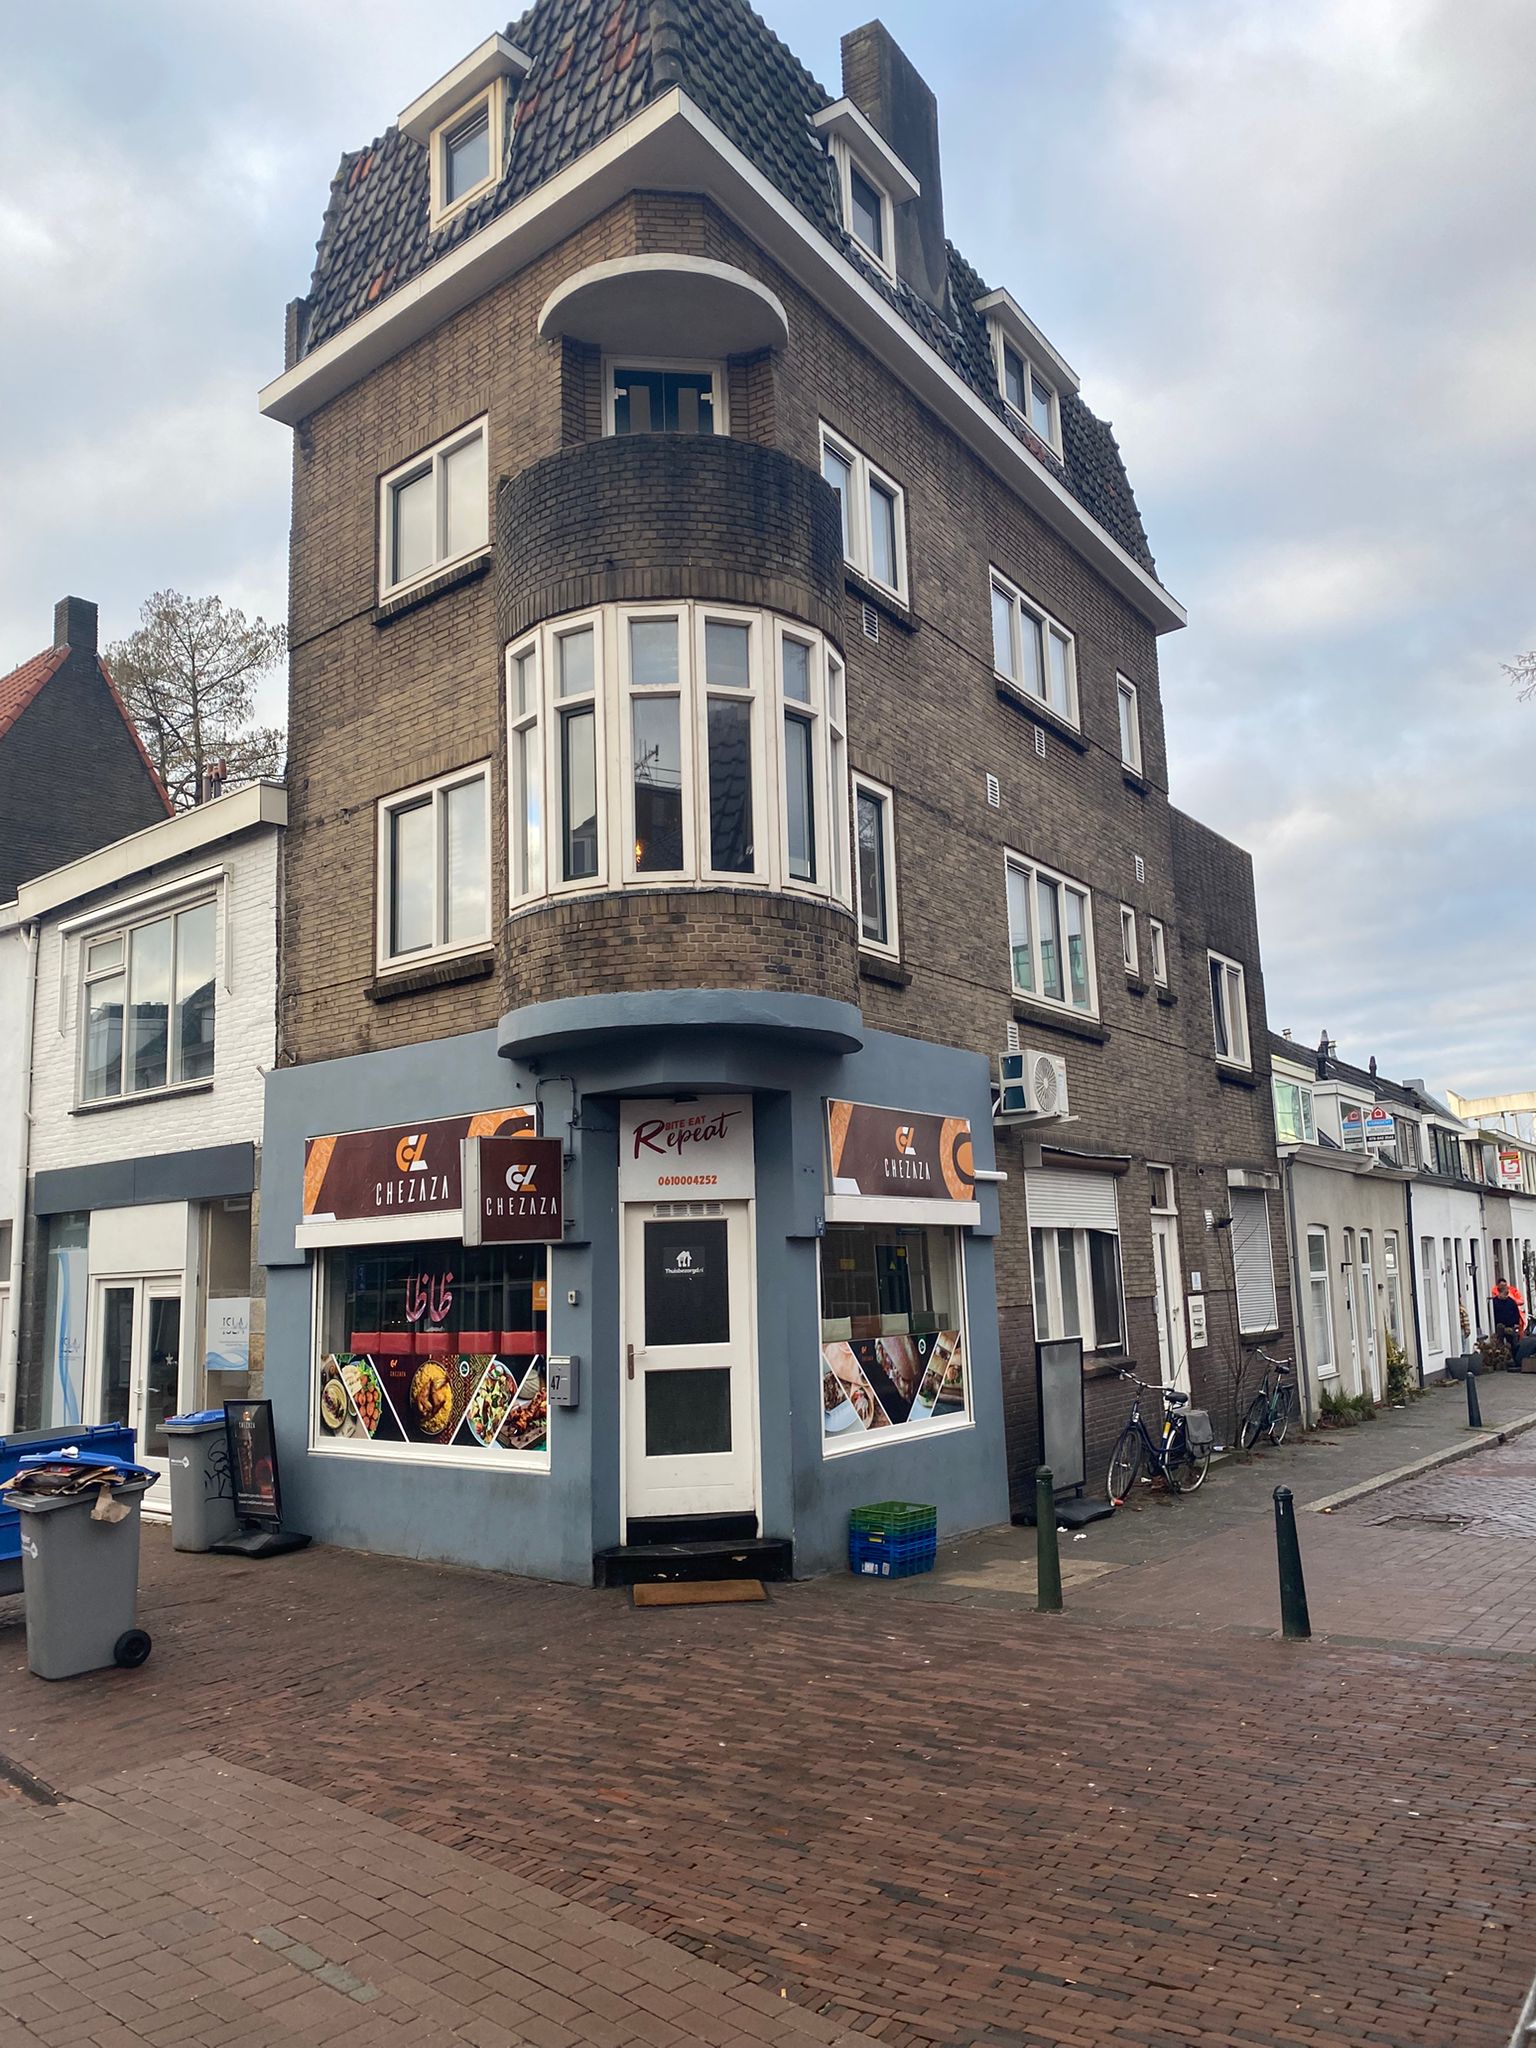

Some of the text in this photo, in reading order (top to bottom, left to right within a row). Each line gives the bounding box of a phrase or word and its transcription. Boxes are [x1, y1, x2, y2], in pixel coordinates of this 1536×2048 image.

[665, 1115, 706, 1131] BITE EAT
[633, 1110, 742, 1159] Repeat
[884, 1158, 931, 1180] CHEZAZA
[376, 1175, 449, 1206] CHEZAZA
[658, 1175, 718, 1186] 0610004252
[485, 1197, 558, 1217] CHEZAZA
[550, 1375, 561, 1390] 47
